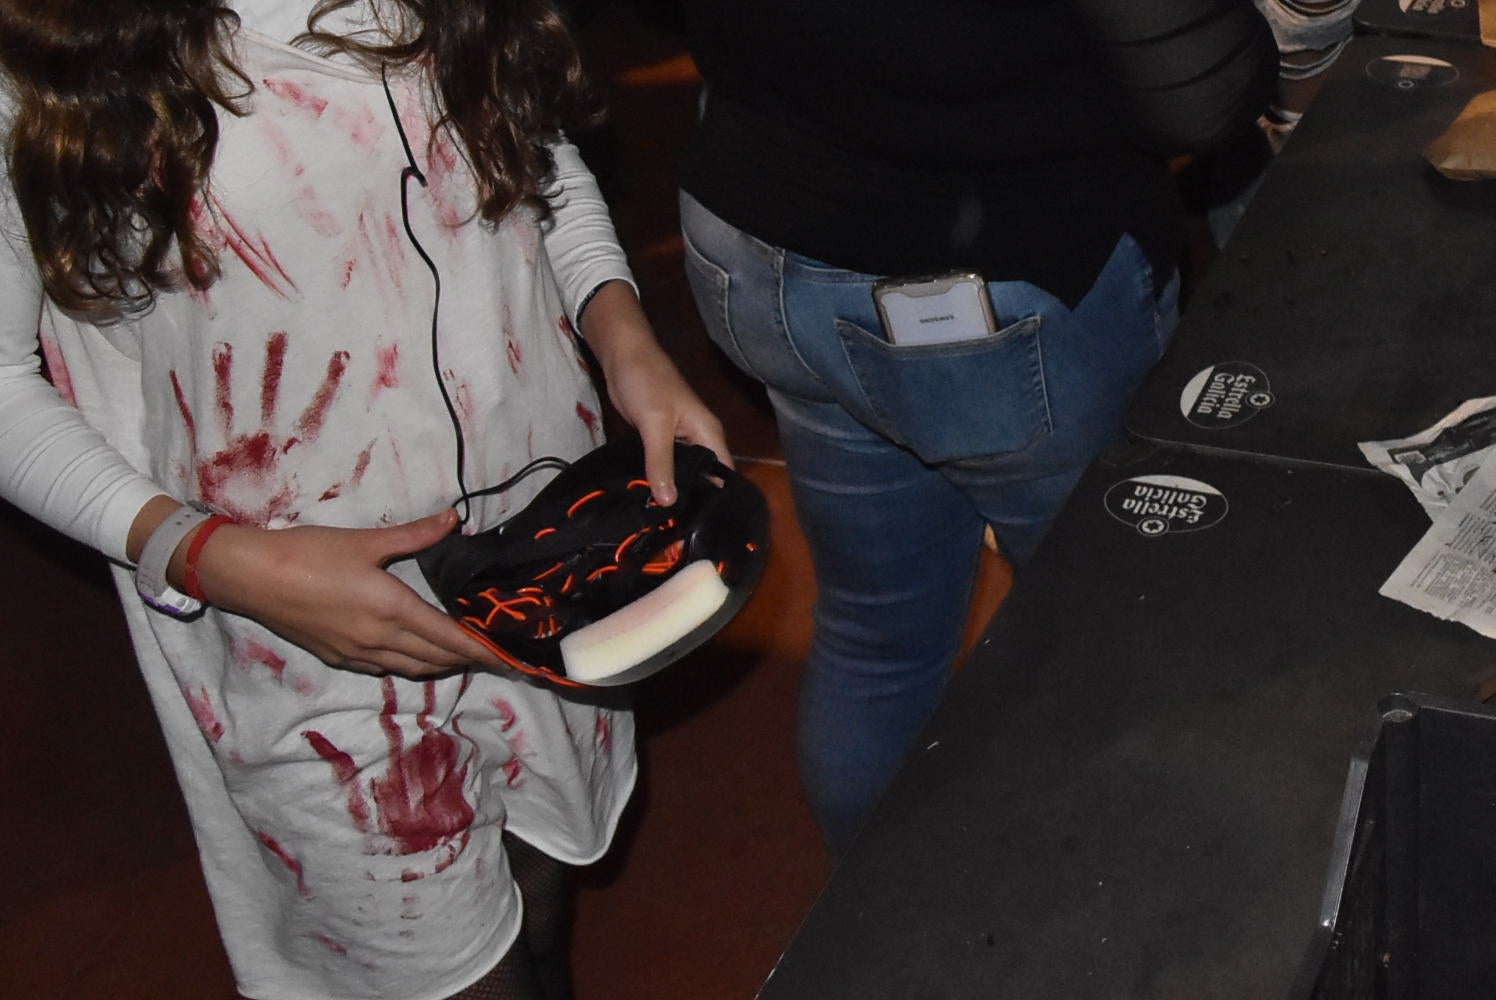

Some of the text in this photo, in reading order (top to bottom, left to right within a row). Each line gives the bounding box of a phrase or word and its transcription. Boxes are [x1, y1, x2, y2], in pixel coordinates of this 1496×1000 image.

[1197, 372, 1235, 414] Galicia
[1217, 374, 1256, 419] Estrella
[1122, 498, 1204, 524] Estrella
[1134, 485, 1207, 510] Galicia
